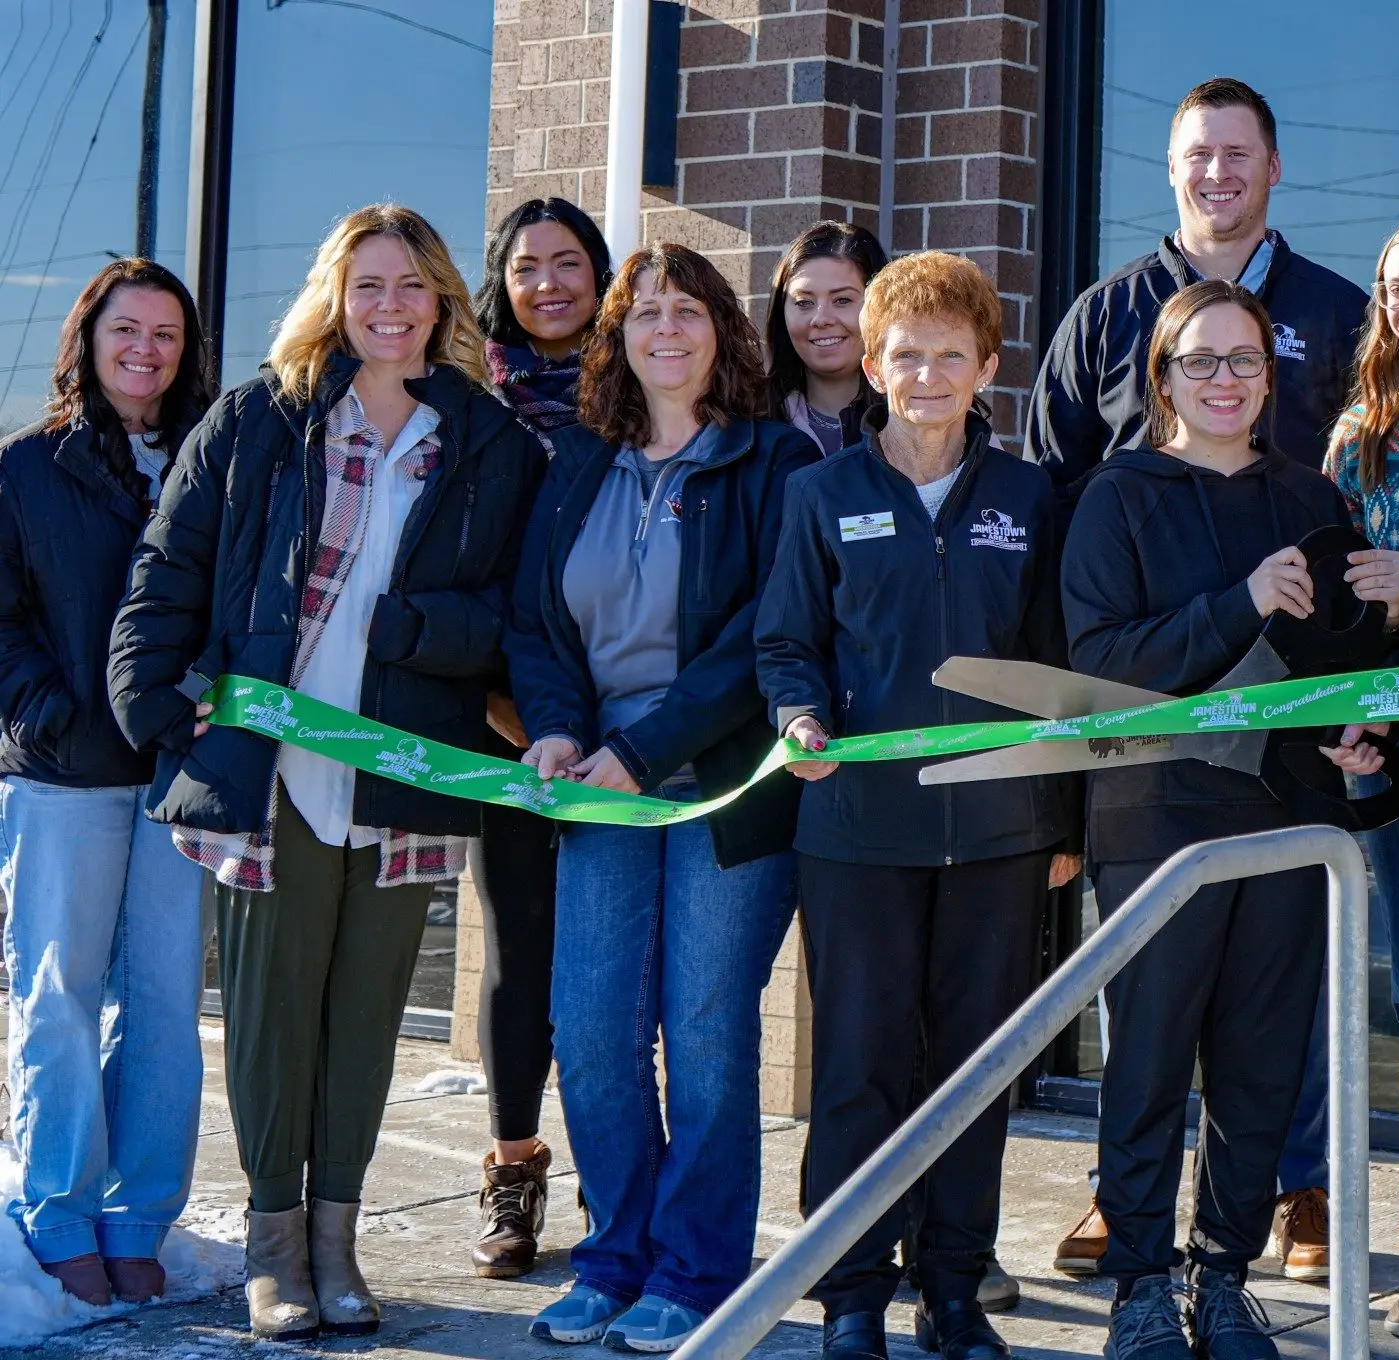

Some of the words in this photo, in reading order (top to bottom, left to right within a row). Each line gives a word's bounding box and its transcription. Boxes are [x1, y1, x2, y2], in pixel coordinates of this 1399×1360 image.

[970, 523, 1026, 537] JAMESTOWN
[988, 534, 1009, 543] AREA
[1262, 680, 1355, 719] Congratulations
[244, 703, 299, 729] JAMESTOWN
[1190, 702, 1257, 717] JAMESTOWN
[255, 716, 277, 730] AREA
[1209, 713, 1237, 722] AREA
[297, 726, 385, 741] Congratulations
[1043, 722, 1070, 732] AREA
[1141, 737, 1162, 747] AREA
[376, 750, 432, 774] JAMESTOWN
[430, 767, 513, 784] Congratulations
